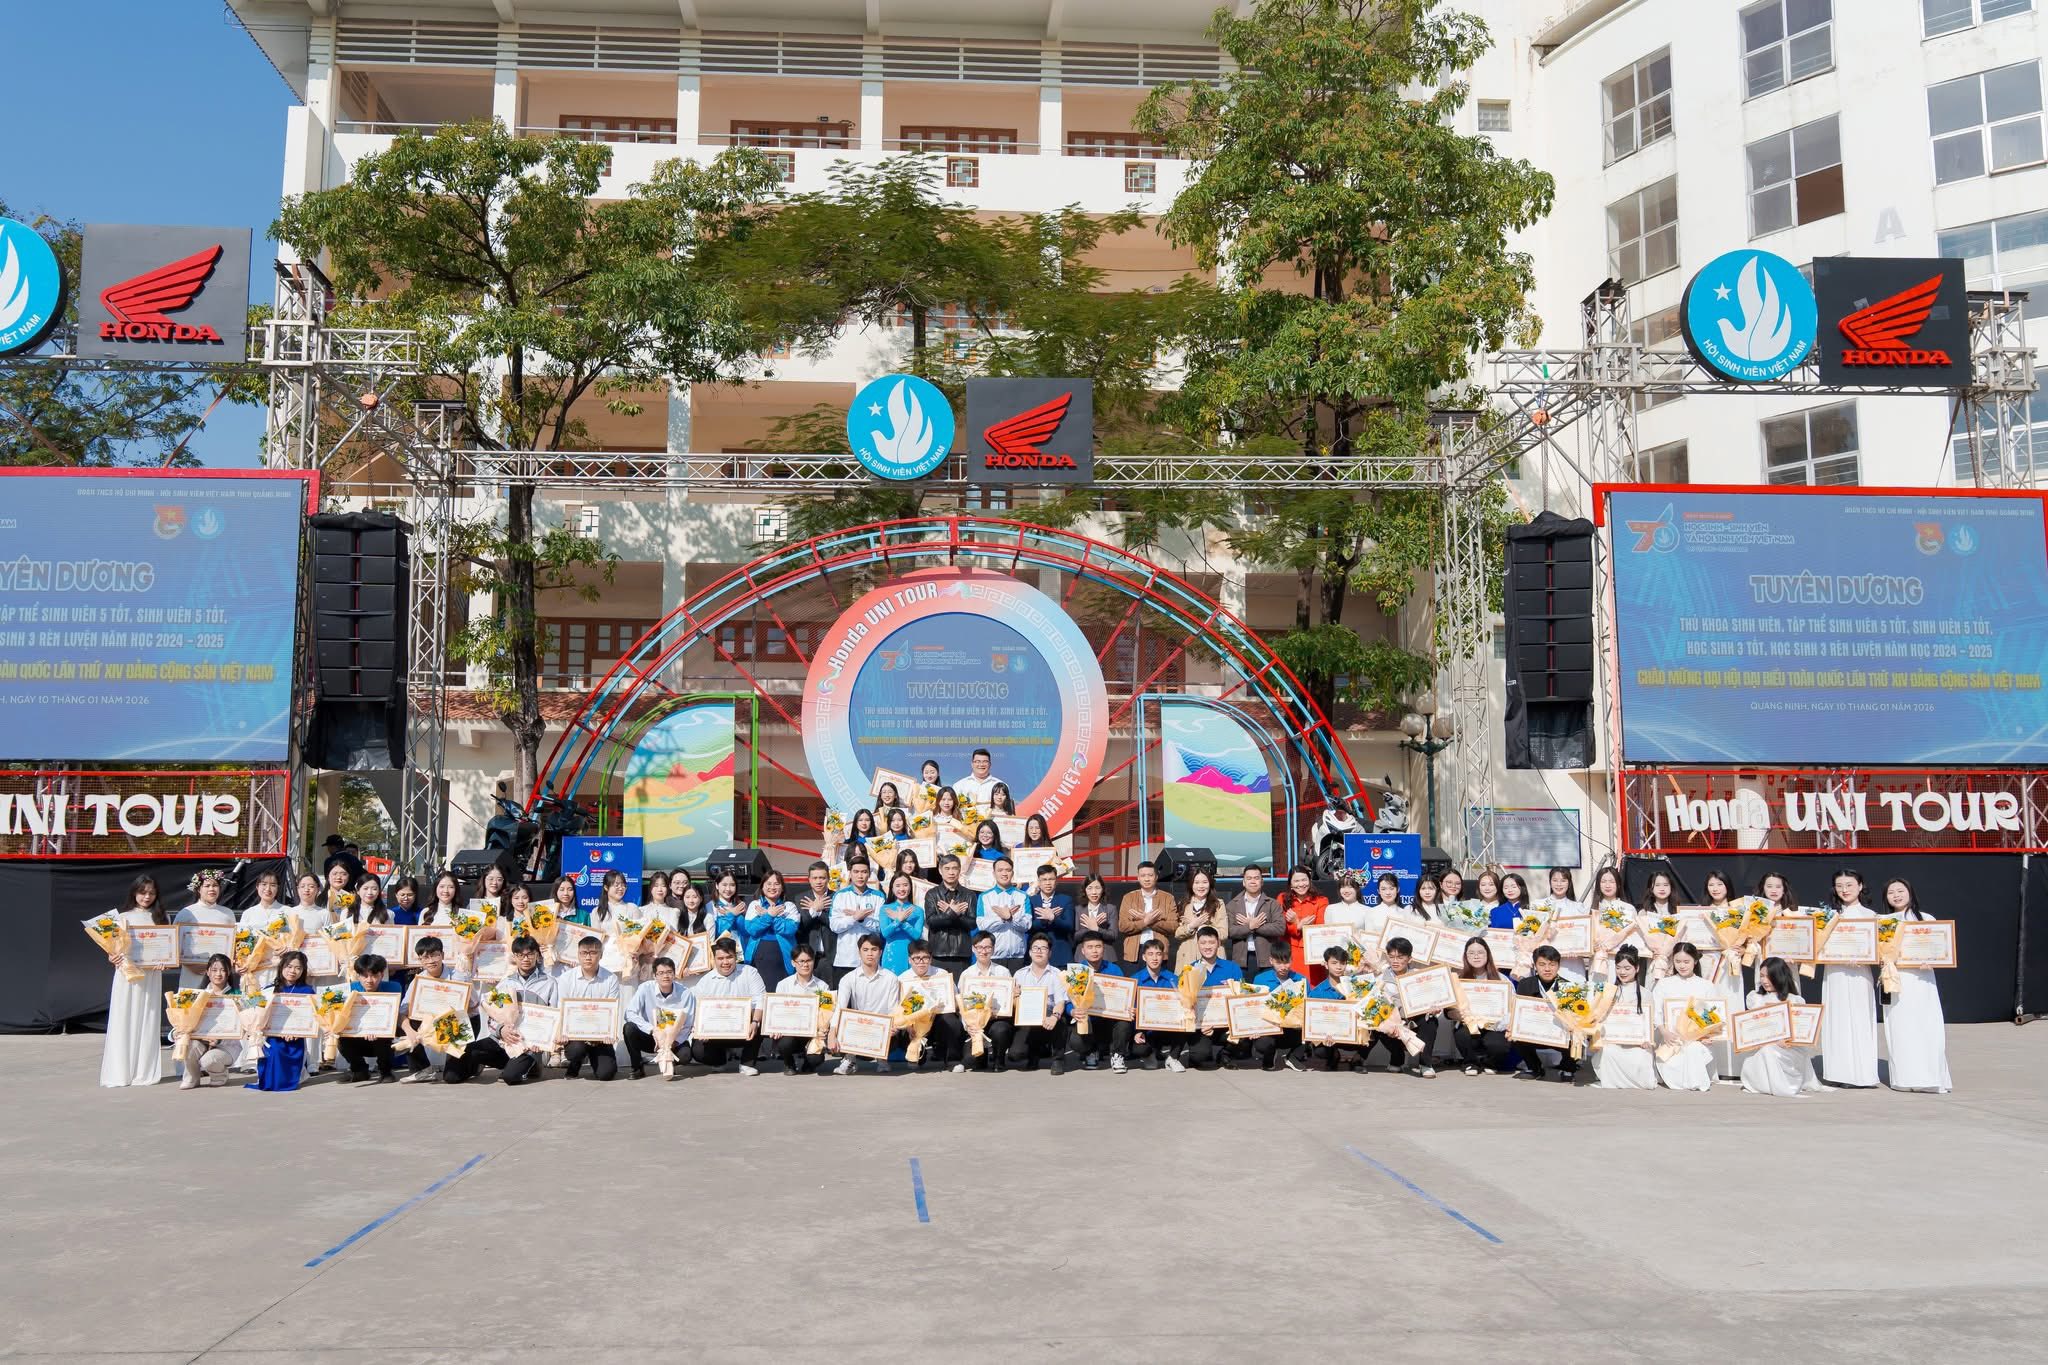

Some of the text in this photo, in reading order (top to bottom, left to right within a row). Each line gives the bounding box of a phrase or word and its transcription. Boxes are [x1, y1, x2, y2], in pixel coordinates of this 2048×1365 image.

[18, 314, 41, 336] NAM
[97, 322, 222, 344] HONDA
[1702, 338, 1807, 377] HỘI SINH VIÊN VIỆT NAM
[1840, 350, 1952, 367] HONDA
[859, 445, 946, 477] HỘI SINH VIÊN VIỆT NAM
[985, 454, 1077, 469] HONDA
[55, 558, 155, 592] DƯƠNG
[1749, 568, 1924, 605] TUYÊN DƯƠNG
[41, 607, 68, 622] SINH
[71, 605, 97, 622] VIÊN
[99, 607, 108, 622] 5
[136, 608, 164, 623] SINH
[166, 605, 193, 623] VIÊN
[195, 608, 203, 623] 5
[827, 582, 939, 672] Honda UNI TOUR
[1702, 618, 1729, 632] KHOA
[1732, 618, 1755, 633] SINH
[1787, 616, 1805, 636] TẬP
[1830, 618, 1852, 633] SINH
[1855, 617, 1878, 633] VIÊN
[1880, 619, 1887, 633] 5
[1912, 619, 1936, 634] SINH
[1939, 618, 1961, 635] VIÊN
[1964, 620, 1971, 635] 5
[0, 629, 224, 650] SINH 3 RÈN LUYỆN NĂM HỌC 2024 2025
[1687, 641, 1708, 658] HỌC
[1711, 641, 1735, 656] SINH
[1737, 641, 1744, 656] 3
[1771, 642, 1791, 658] HỌC
[1794, 642, 1816, 657] SINH
[1819, 642, 1827, 657] 3
[1830, 639, 1849, 657] RÈN
[1852, 640, 1881, 660] LUYỆN
[1884, 641, 1907, 658] NĂM
[1911, 644, 1930, 660] HỌC
[1933, 644, 1957, 658] 2024
[1968, 645, 1993, 659] 2025
[20, 659, 51, 681] QUỐC
[104, 664, 122, 680] XIV
[125, 659, 157, 680] ĐẢNG
[160, 662, 191, 683] CỘNG
[193, 660, 216, 680] SẢN
[219, 661, 244, 684] VIỆT
[246, 665, 274, 681] NAM
[1788, 668, 1815, 687] TOÀN
[1816, 668, 1845, 688] QUỐC
[1891, 672, 1907, 687] XIV
[1940, 671, 1969, 690] CỘNG
[1993, 671, 2014, 690] VIỆT
[2016, 674, 2042, 690] NAM
[126, 695, 150, 705] 2026
[907, 679, 1008, 699] TUYÊN DƯƠNG
[1913, 703, 1935, 712] 2026
[1057, 767, 1081, 797] VIỆT
[84, 793, 241, 837] TOUR
[1038, 794, 1064, 821] HẤT
[1664, 788, 2020, 833] Honda UNI TOUR
